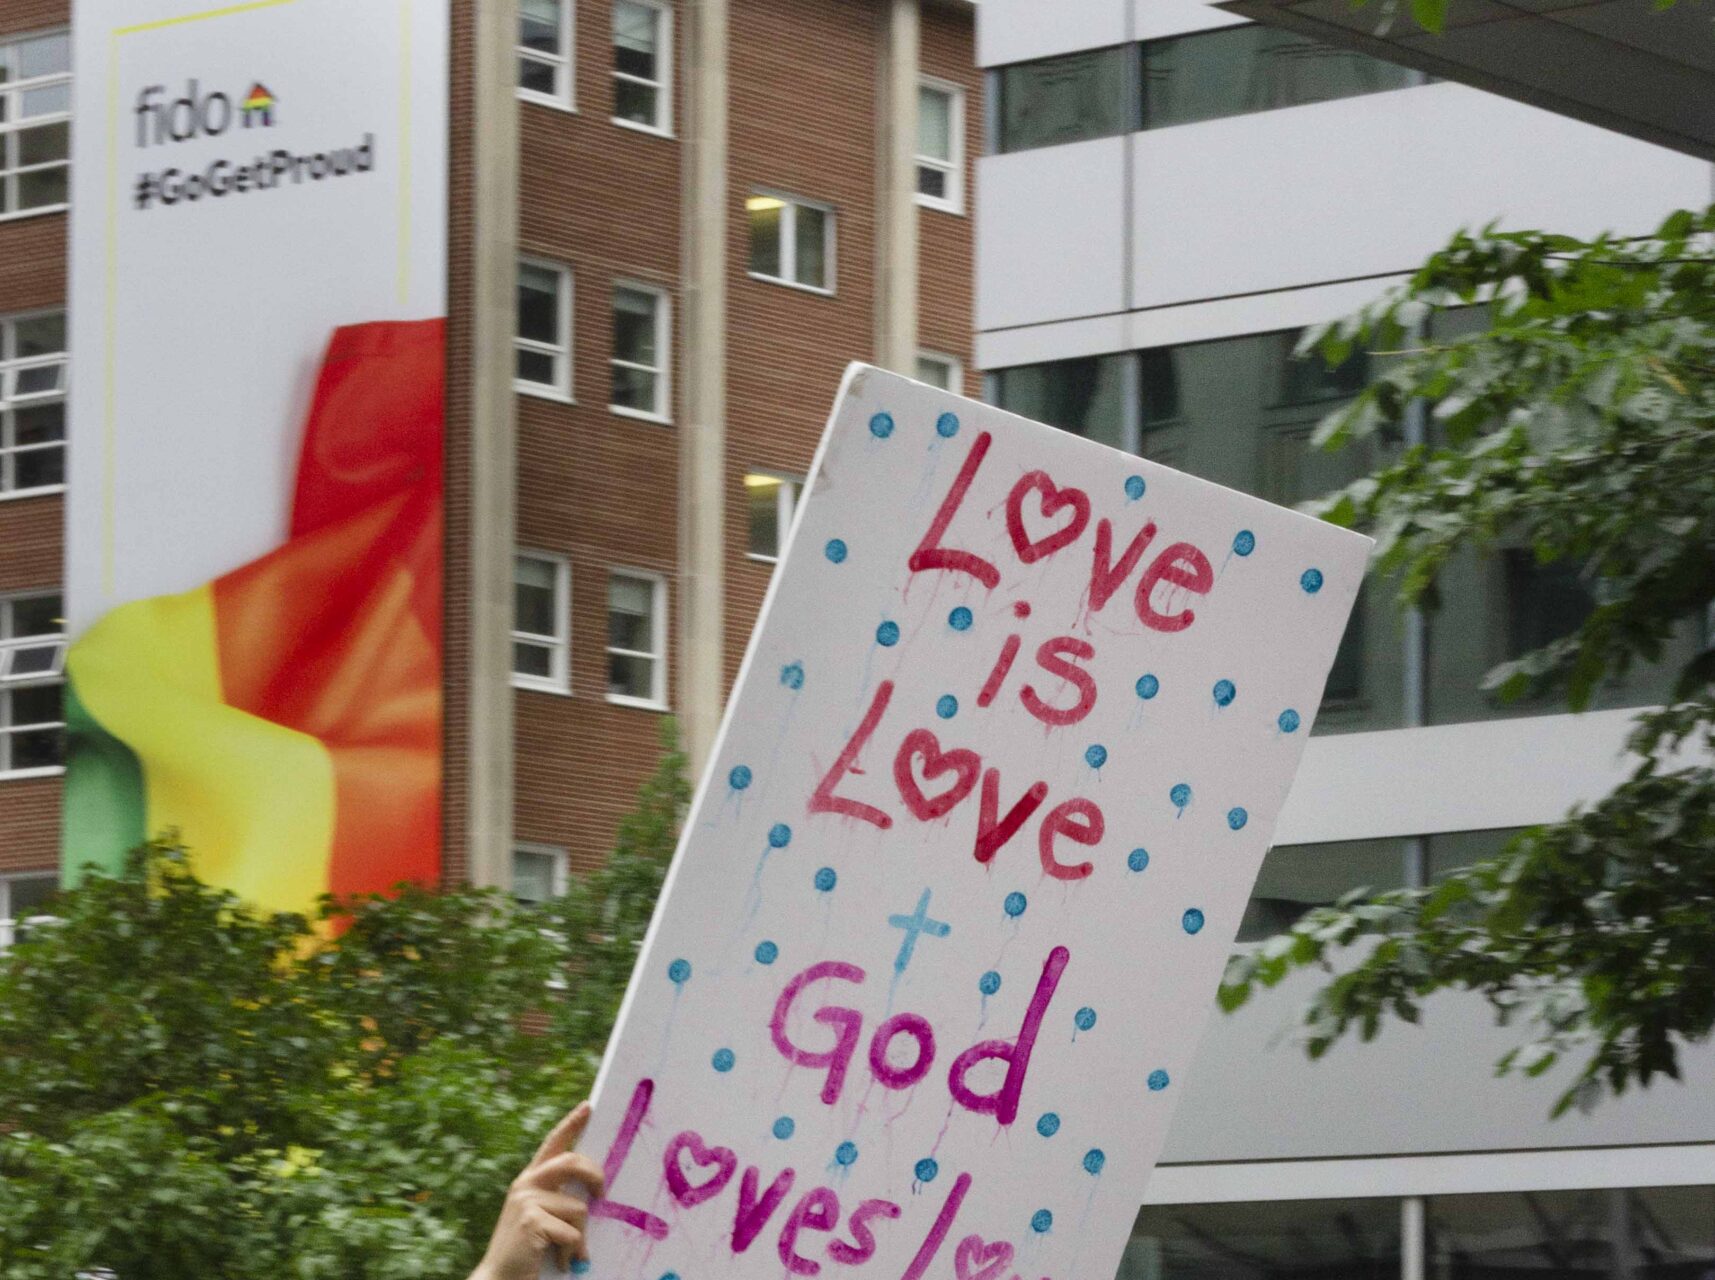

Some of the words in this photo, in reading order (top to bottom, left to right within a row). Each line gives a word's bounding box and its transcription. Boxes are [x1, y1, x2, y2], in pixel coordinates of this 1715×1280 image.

[133, 132, 375, 209] #GoGetProud
[134, 78, 231, 148] fido
[908, 431, 1214, 633] Love
[976, 600, 1098, 727] is
[807, 680, 1105, 881] Love
[770, 944, 1071, 1126] God
[586, 1077, 901, 1276] Loves
